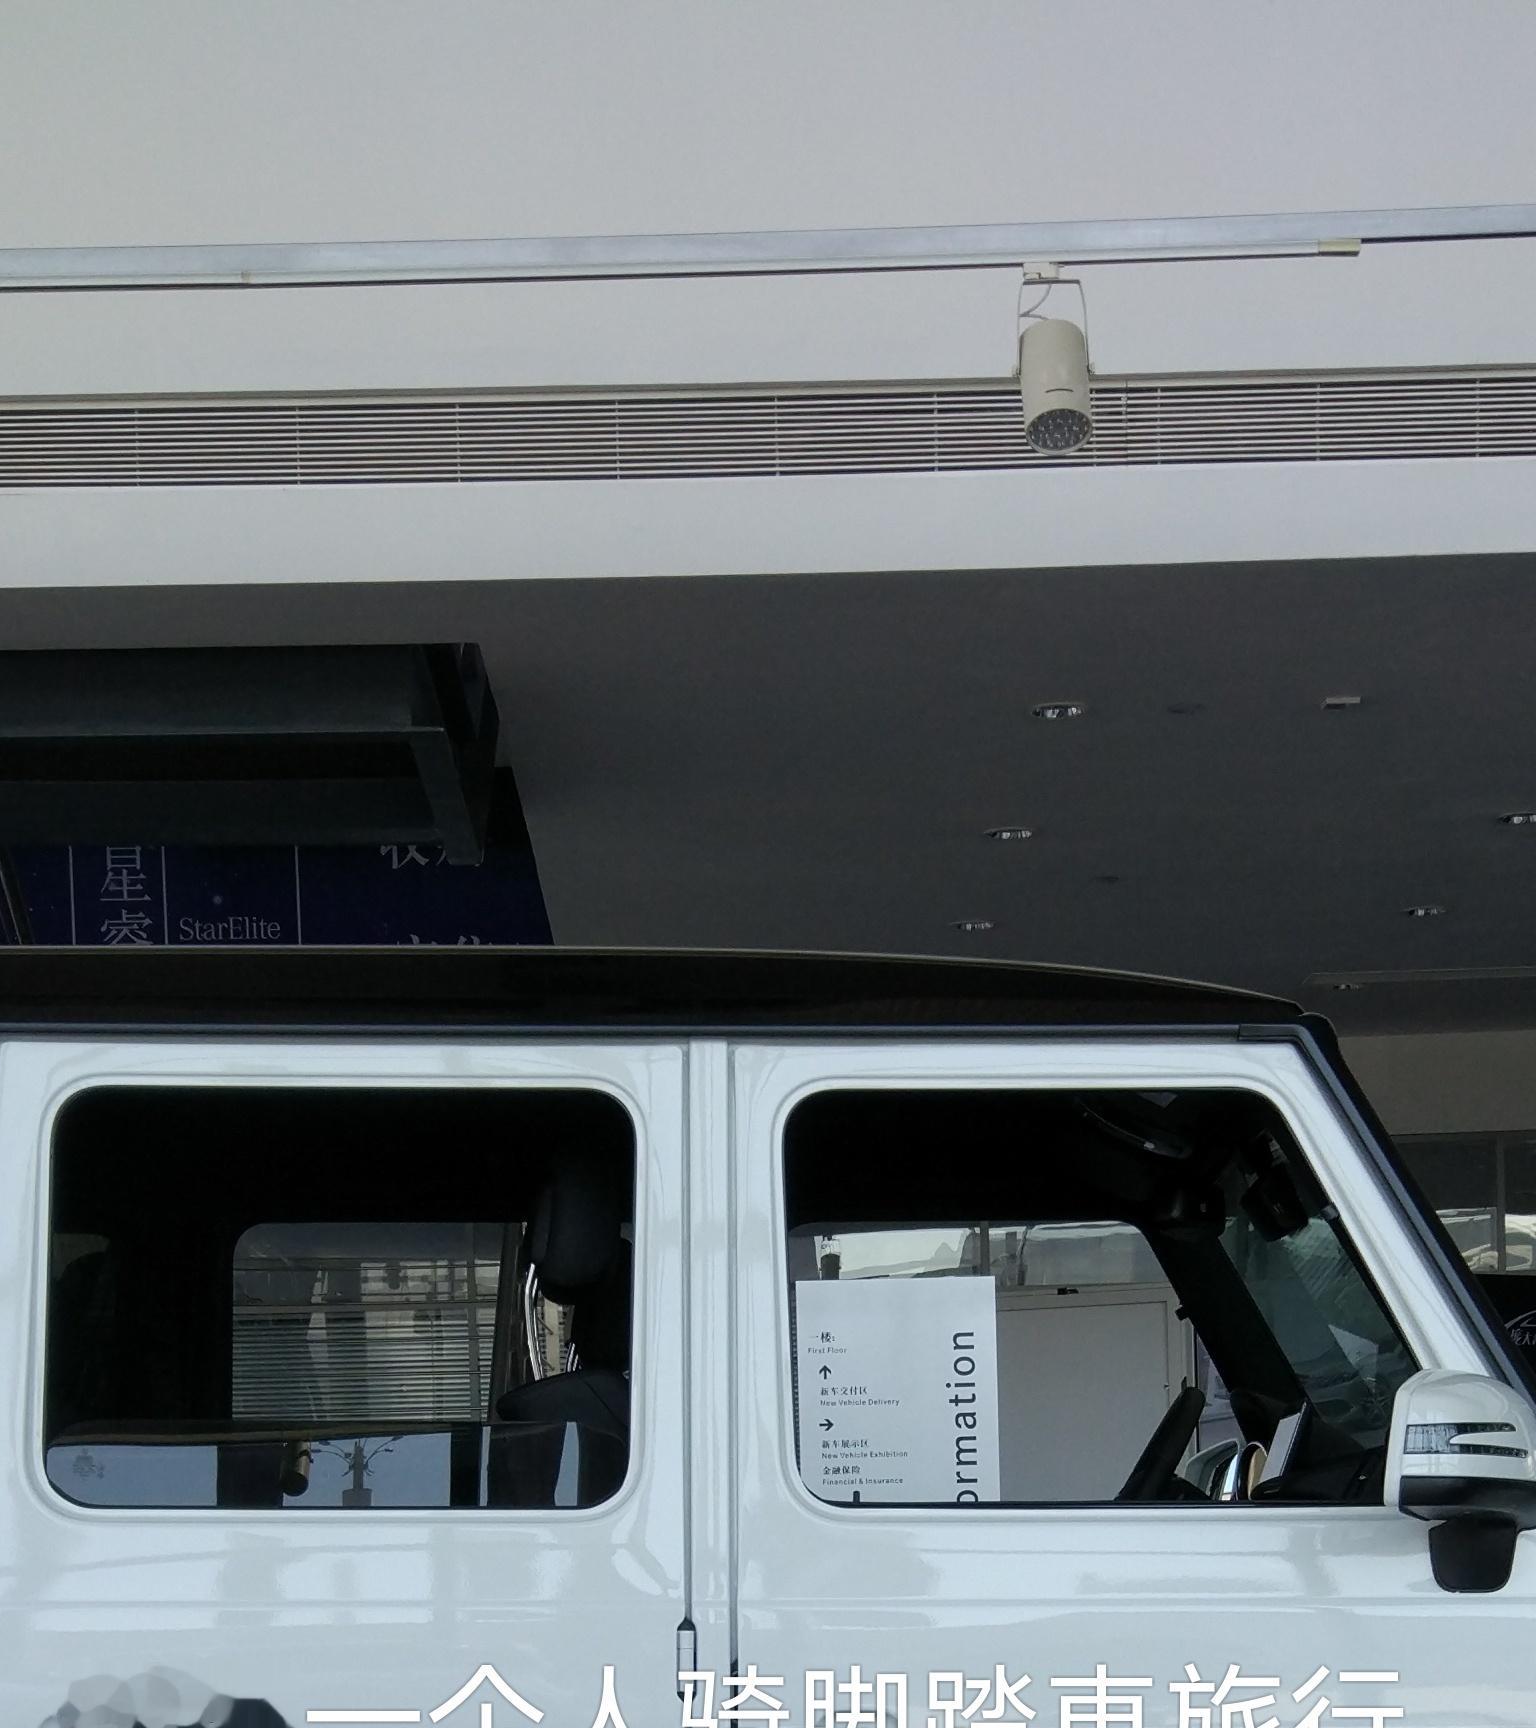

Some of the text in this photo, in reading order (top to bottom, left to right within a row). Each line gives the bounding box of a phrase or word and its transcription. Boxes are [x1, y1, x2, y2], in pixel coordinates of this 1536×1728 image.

[178, 916, 281, 942] StarElite
[827, 1346, 848, 1354] Floor
[820, 1398, 901, 1407] New Vehicle Delivery
[821, 1450, 908, 1460] New Vehicle Exhibition
[823, 1465, 861, 1475] 金融保险
[822, 1478, 857, 1486] Financial
[865, 1477, 904, 1485] Insurance
